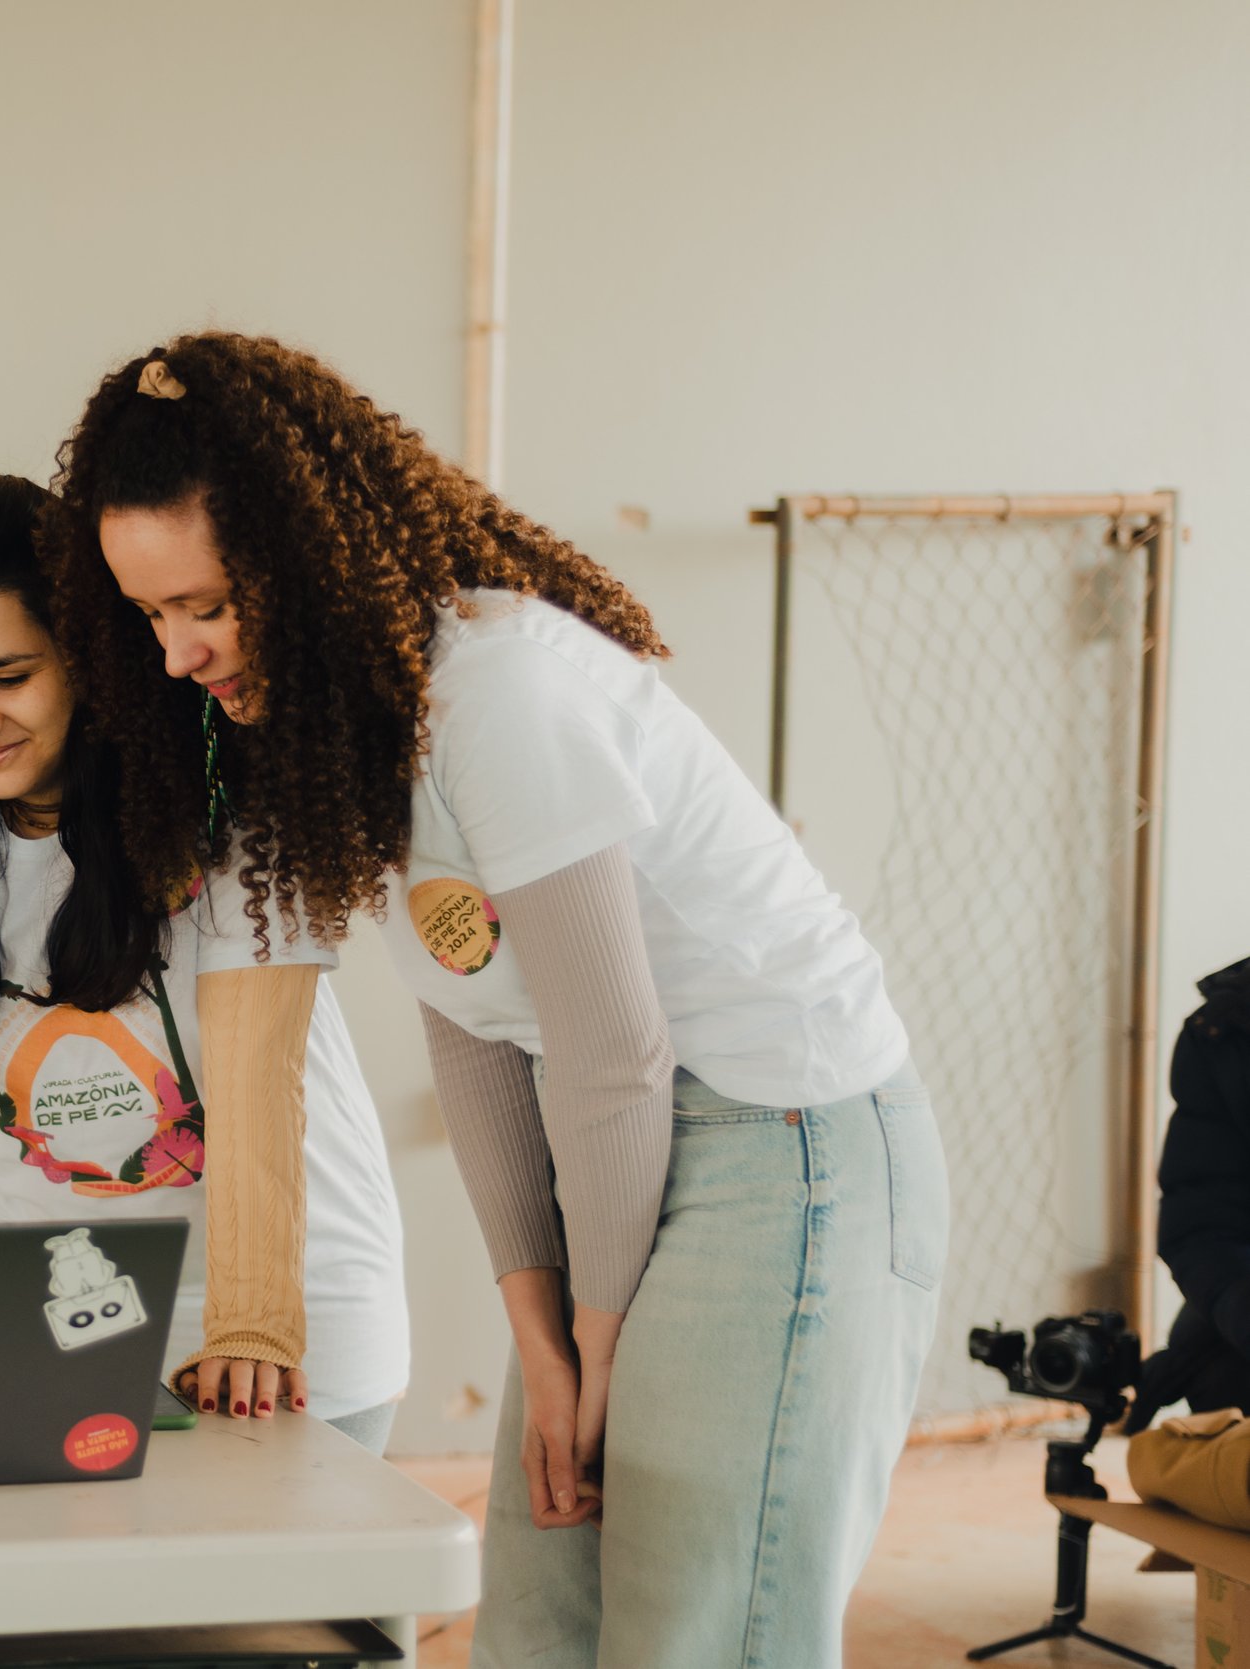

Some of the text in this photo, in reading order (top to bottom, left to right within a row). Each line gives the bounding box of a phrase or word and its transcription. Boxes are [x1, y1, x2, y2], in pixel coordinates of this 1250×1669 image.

[423, 895, 472, 941] AMAZÔNIA
[430, 921, 458, 951] DE PÉ
[446, 926, 477, 955] 2024
[42, 1070, 125, 1089] VIRADA CULTURAL
[34, 1081, 142, 1111] AMAZÔNIA
[36, 1103, 99, 1127] DE PÉ
